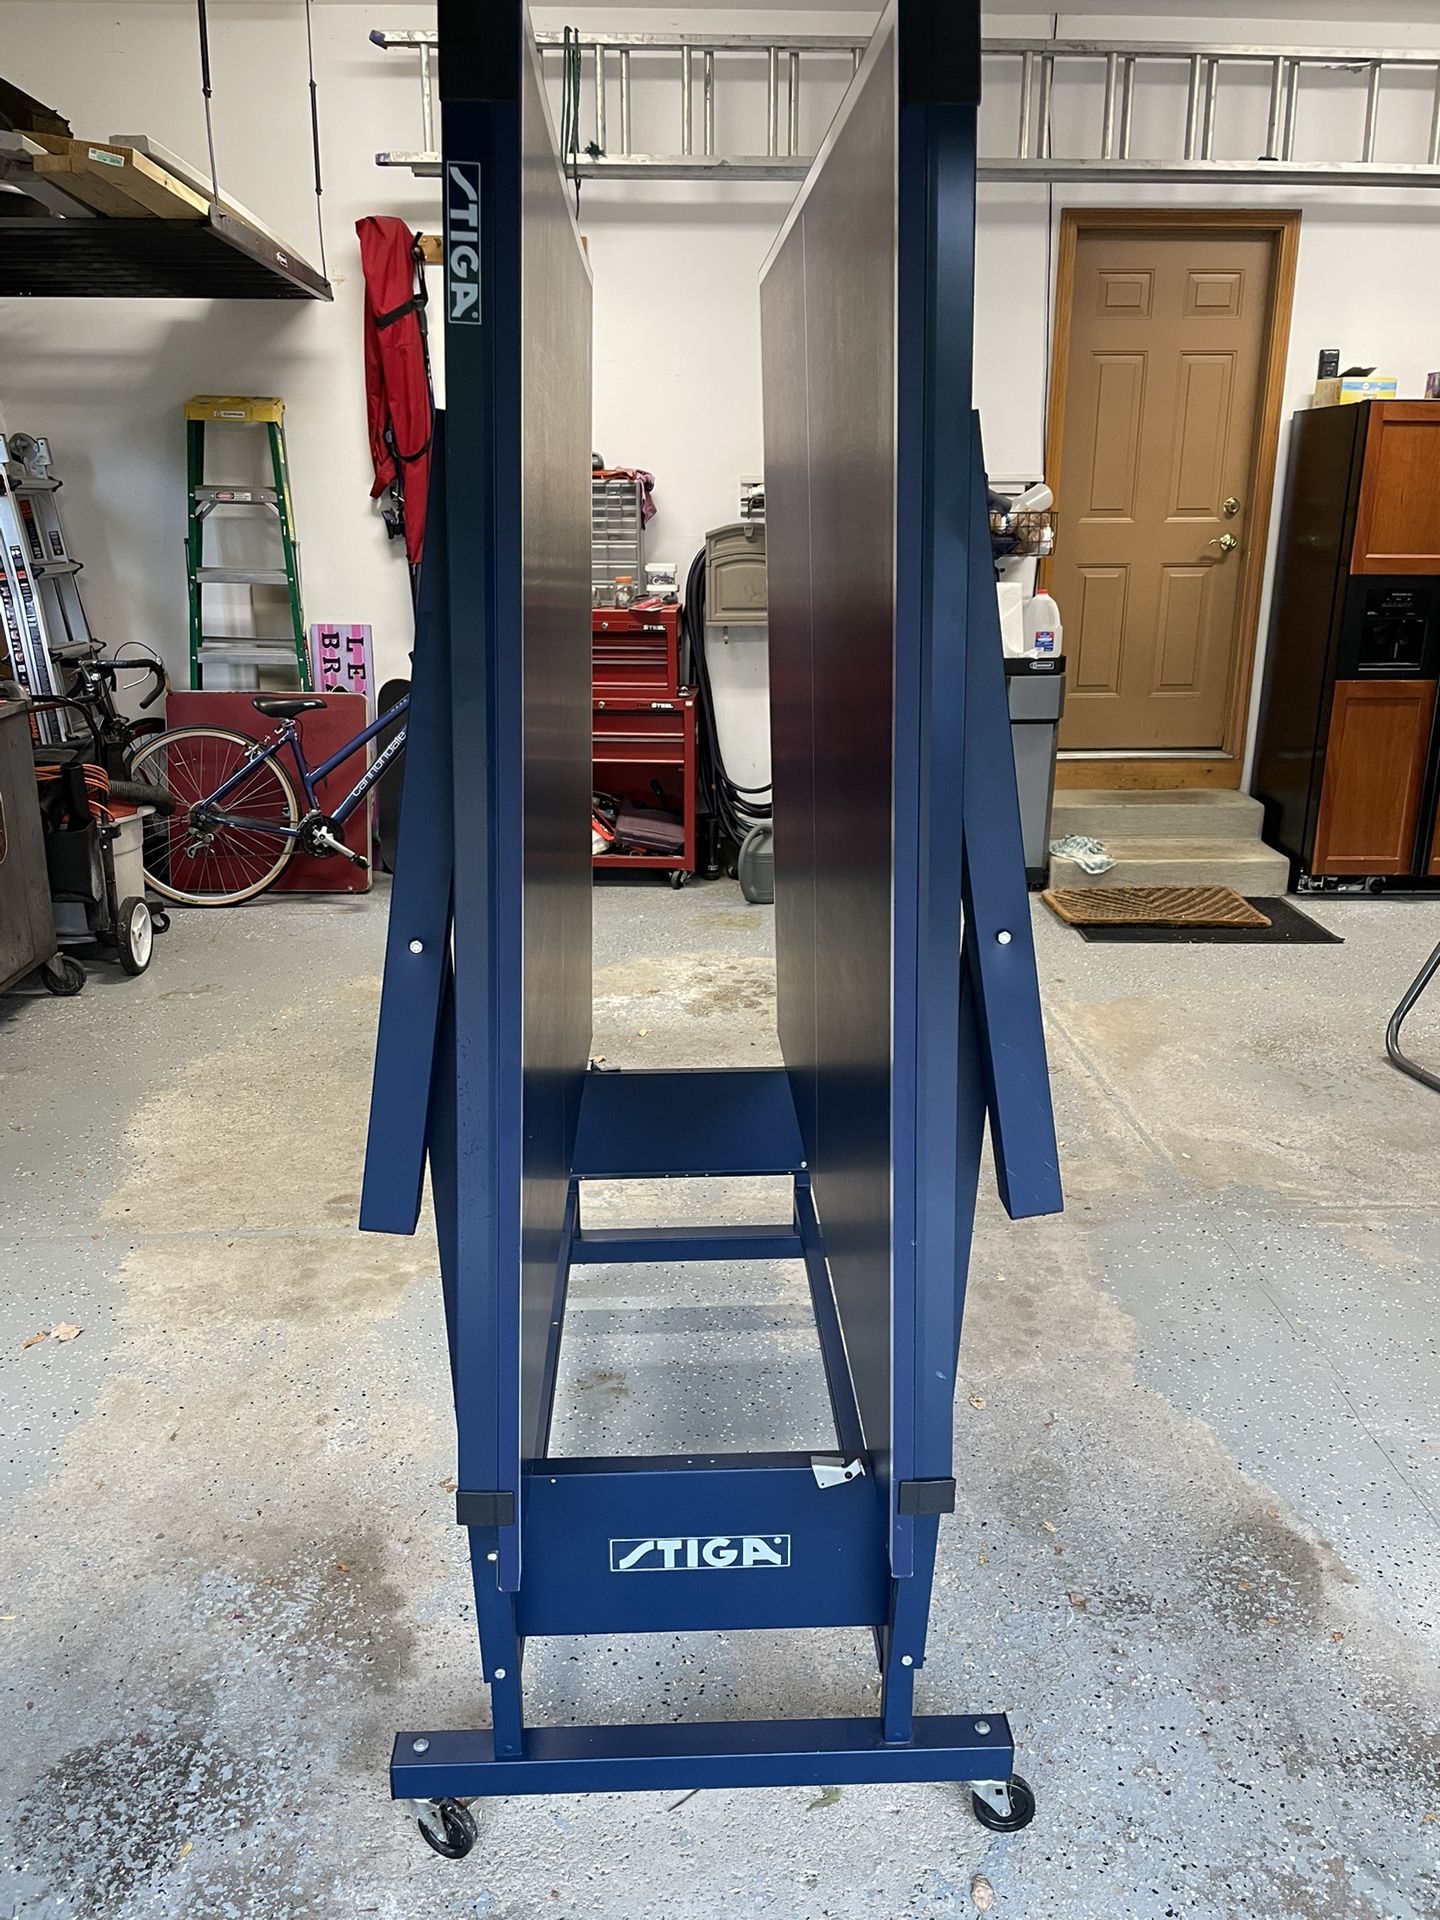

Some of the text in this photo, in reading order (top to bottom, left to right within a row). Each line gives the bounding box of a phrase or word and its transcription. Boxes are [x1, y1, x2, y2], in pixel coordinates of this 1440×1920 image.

[450, 166, 479, 318] STIGA
[346, 636, 366, 695] LE
[352, 730, 407, 797] cannondale
[618, 1537, 782, 1570] STIGA
